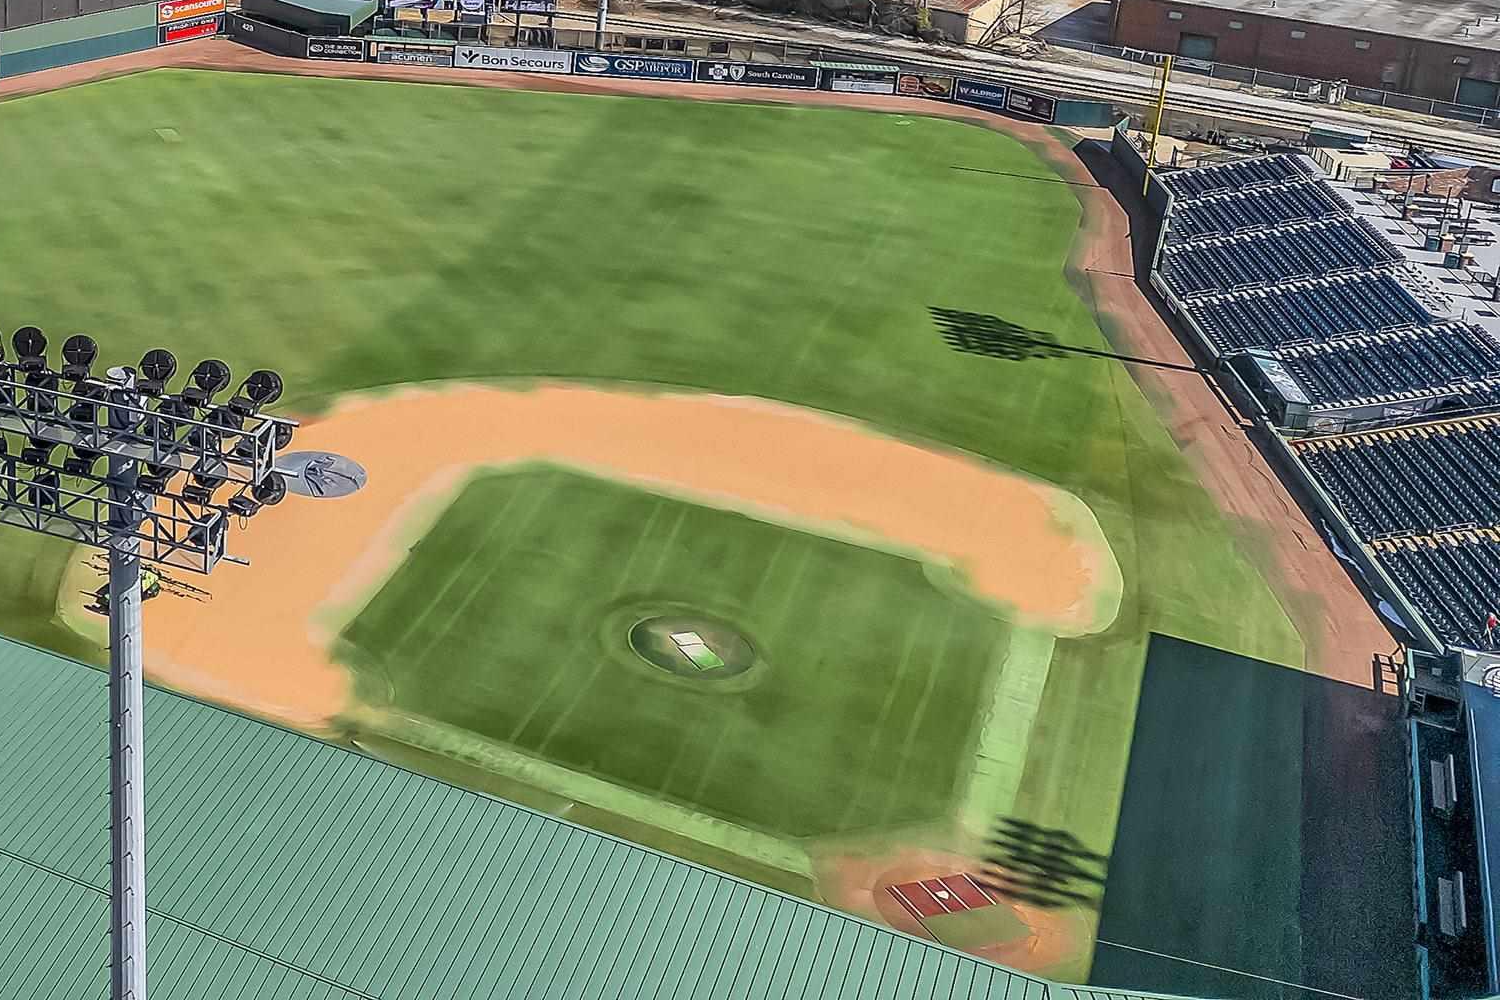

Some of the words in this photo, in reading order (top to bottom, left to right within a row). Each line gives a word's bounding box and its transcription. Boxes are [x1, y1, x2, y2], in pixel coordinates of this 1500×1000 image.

[390, 53, 433, 64] acumen
[481, 55, 508, 67] Bon
[510, 57, 565, 71] Secours
[614, 58, 645, 72] GSP
[747, 69, 771, 80] South
[771, 71, 806, 81] Carolina
